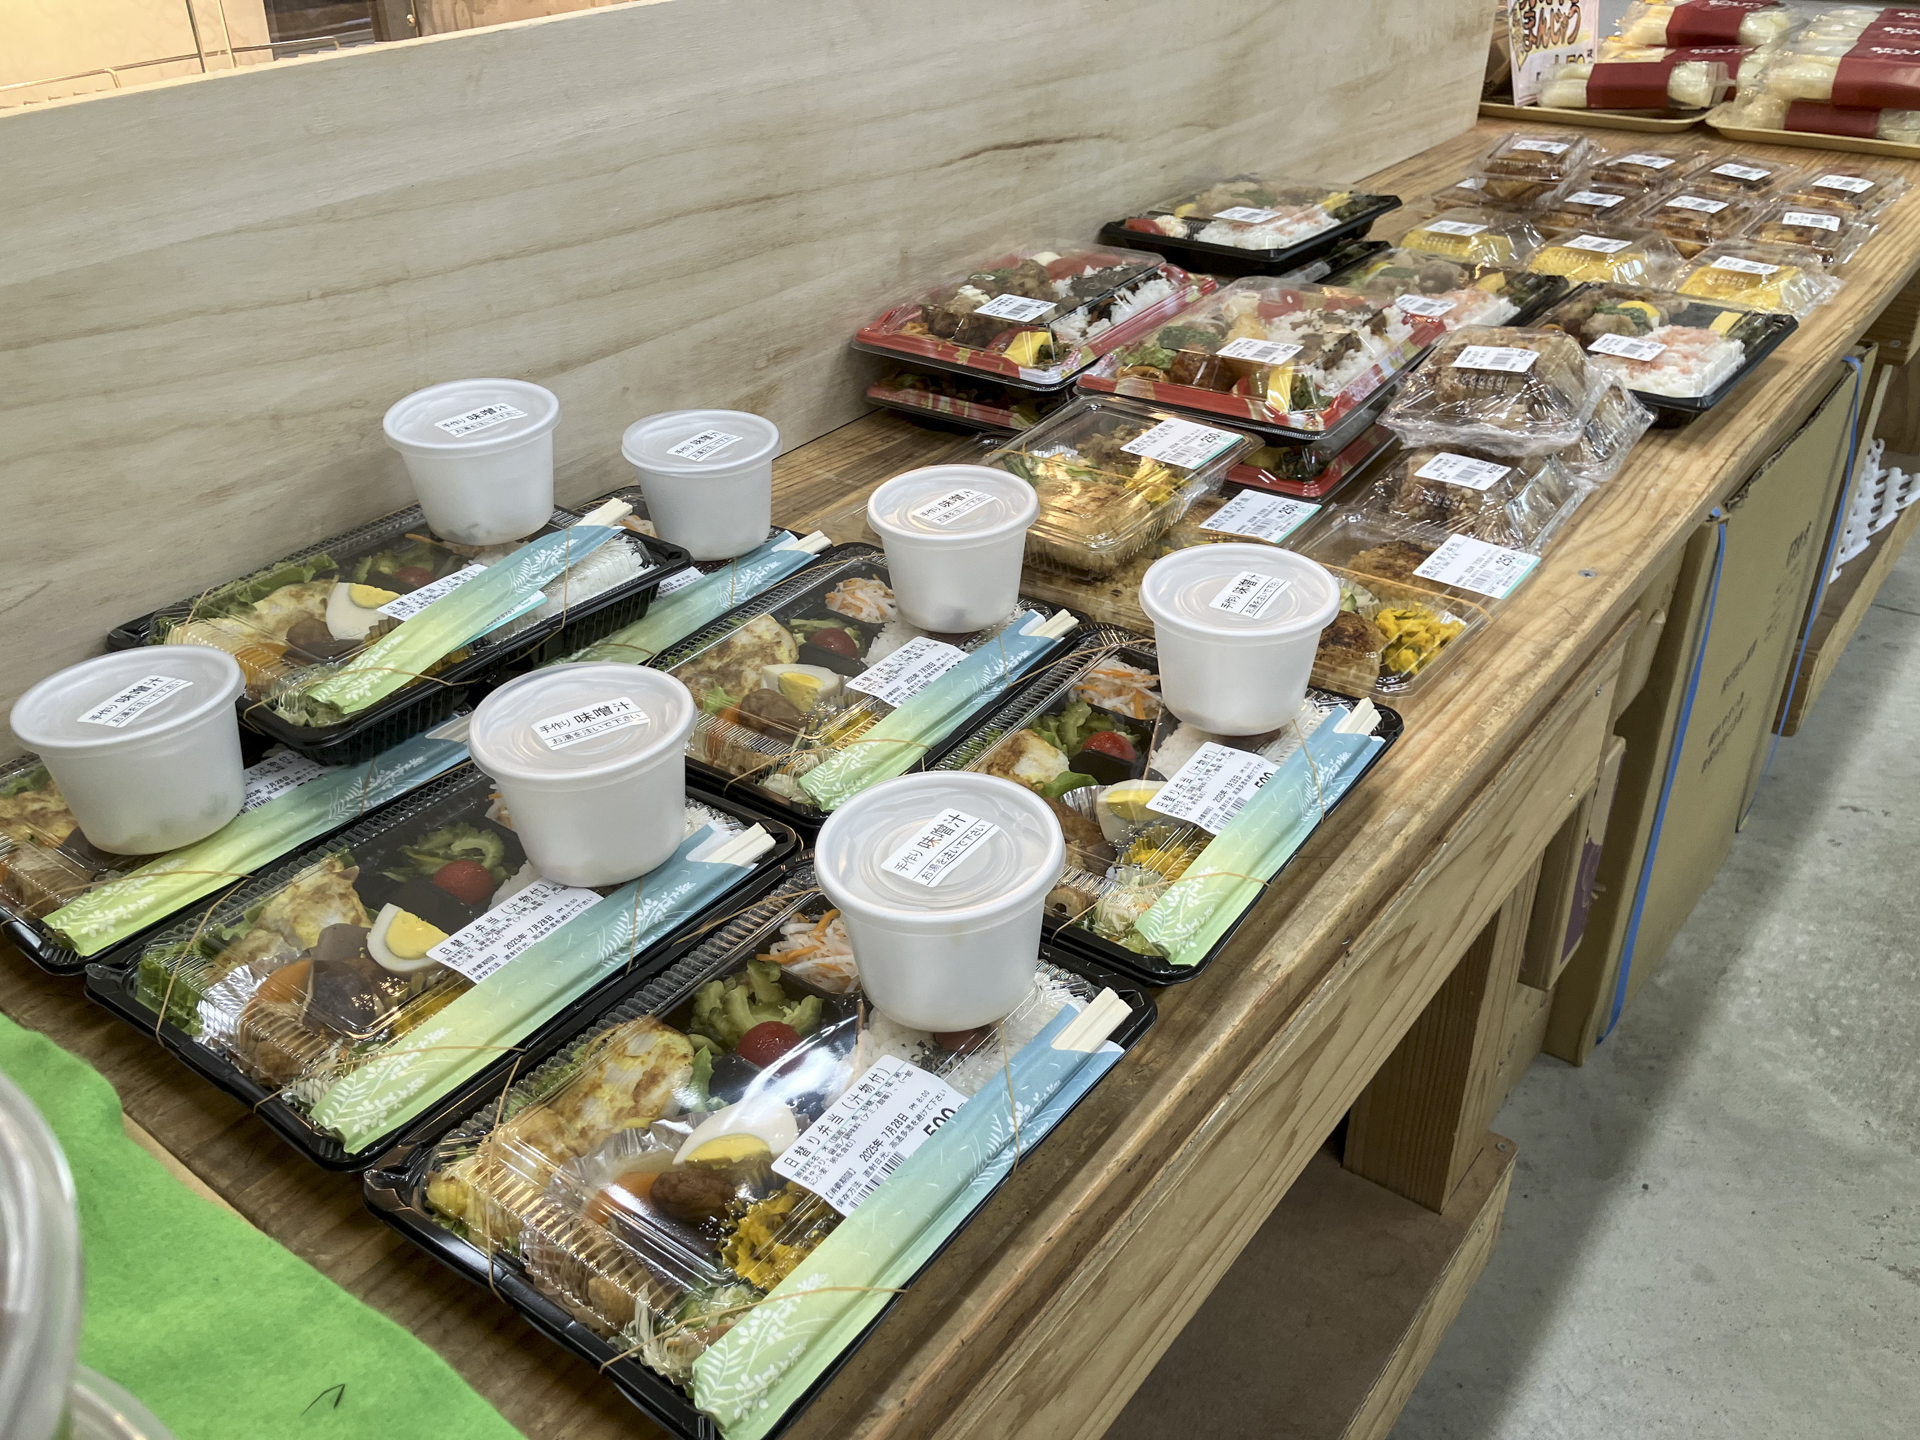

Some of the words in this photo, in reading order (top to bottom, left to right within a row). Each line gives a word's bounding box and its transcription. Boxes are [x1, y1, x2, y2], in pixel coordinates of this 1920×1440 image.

[1496, 554, 1516, 566] 250
[539, 718, 571, 733] 手作り
[573, 701, 630, 724] 味噌汁
[894, 849, 924, 872] 手作り
[916, 814, 966, 850] 味噌汁
[921, 824, 986, 880] お湯を注いで下さい
[440, 884, 551, 955] 日替り弁当（汁物付）
[504, 933, 529, 950] 2025年
[527, 915, 556, 933] 7月28日
[784, 1068, 892, 1169] 日替り弁当（汁物付）
[825, 1168, 857, 1199] 【消費期限】
[859, 1138, 885, 1162] 2025年
[882, 1113, 910, 1139] 7月28日
[909, 1102, 918, 1110] PM
[835, 1181, 863, 1207] 保存方法
